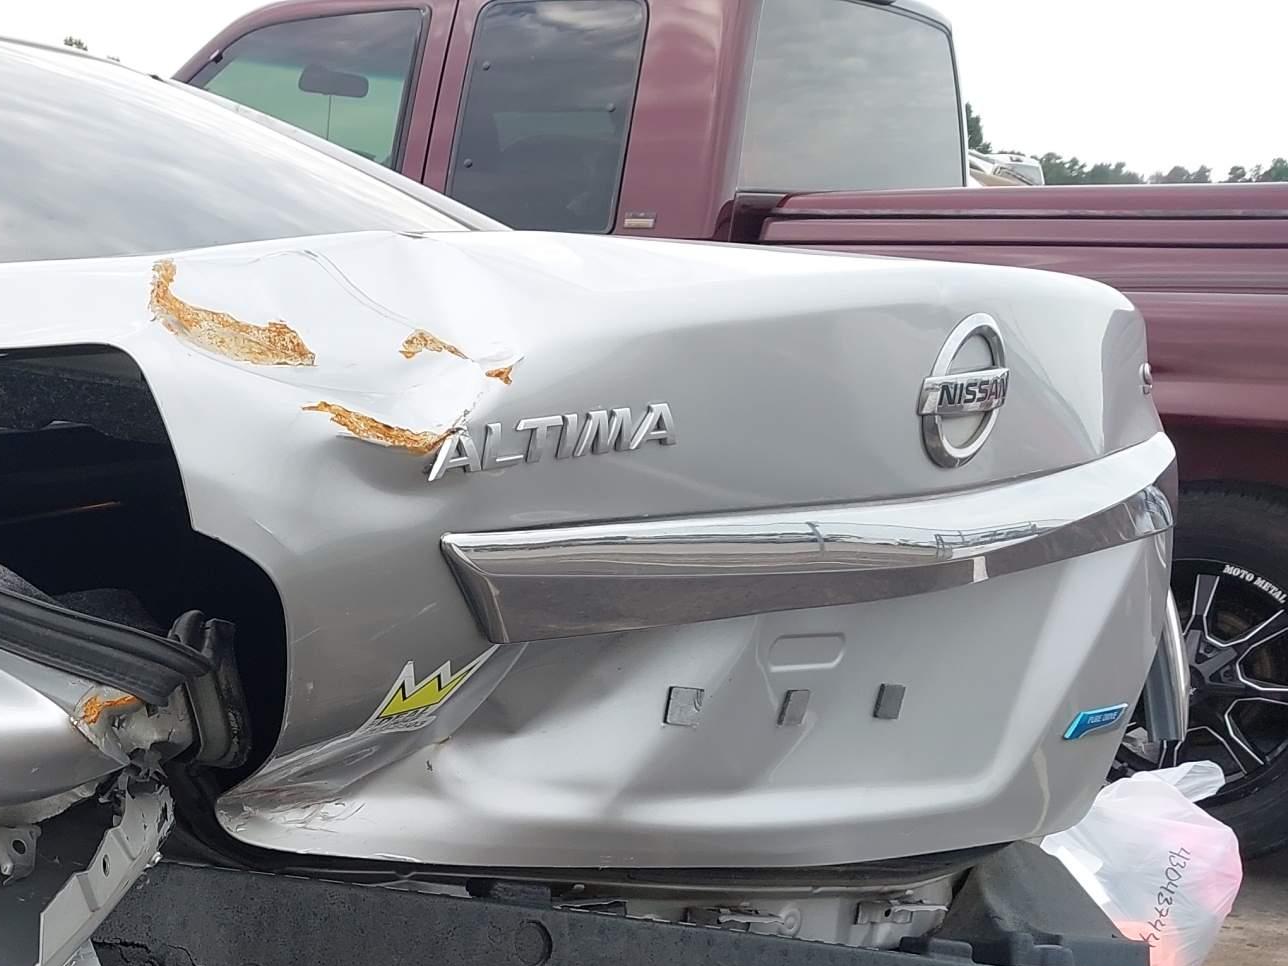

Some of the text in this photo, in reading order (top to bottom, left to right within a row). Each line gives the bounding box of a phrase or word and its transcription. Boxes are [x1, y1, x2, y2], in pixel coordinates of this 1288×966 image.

[937, 371, 1009, 406] NISSAN
[426, 402, 677, 482] ALTIMA
[1222, 564, 1287, 604] MOTO METAL
[1139, 847, 1191, 948] 43043744
